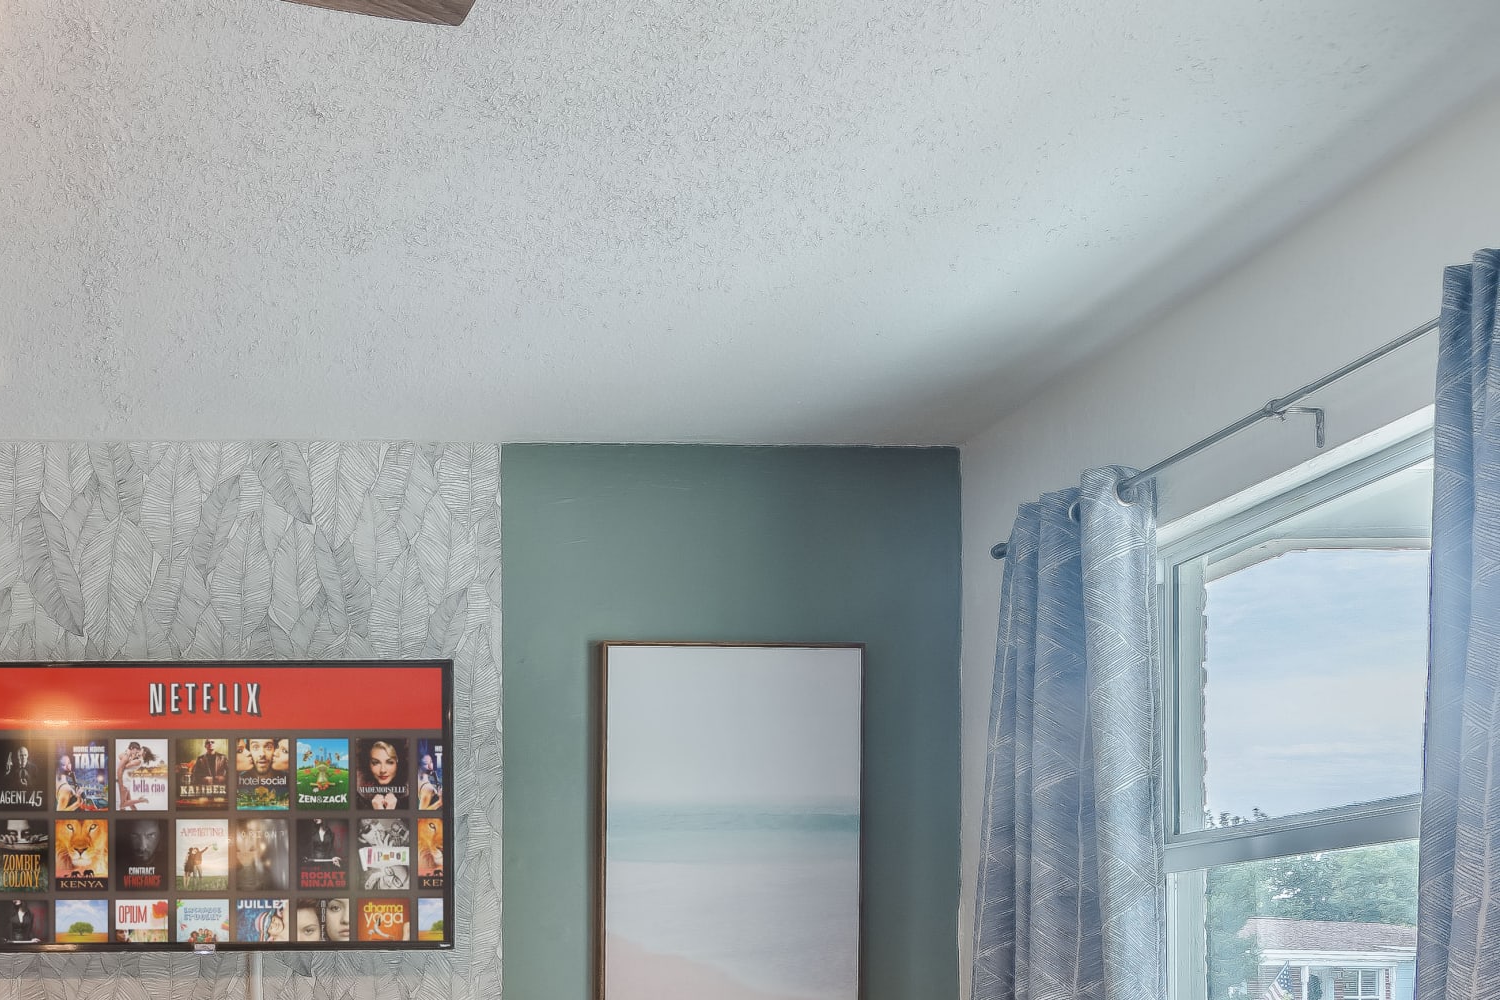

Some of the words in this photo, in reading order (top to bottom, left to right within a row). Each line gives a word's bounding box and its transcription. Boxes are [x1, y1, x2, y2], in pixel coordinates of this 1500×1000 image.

[149, 682, 261, 717] NETFLIX
[73, 753, 105, 768] TAXI
[132, 780, 150, 792] bella
[151, 780, 166, 792] ciao
[238, 776, 260, 785] hotel
[261, 776, 287, 785] social
[180, 785, 226, 796] KALIBER
[3, 855, 41, 871] ZOMBIE
[128, 867, 155, 875] CONTRACT
[301, 871, 346, 879] ROCKET
[3, 871, 40, 887] COLONY
[301, 880, 333, 888] NINJA
[237, 899, 287, 909] JUILLET
[364, 902, 403, 913] dharma
[118, 905, 147, 924] OPIUM
[364, 911, 403, 928] yoga
